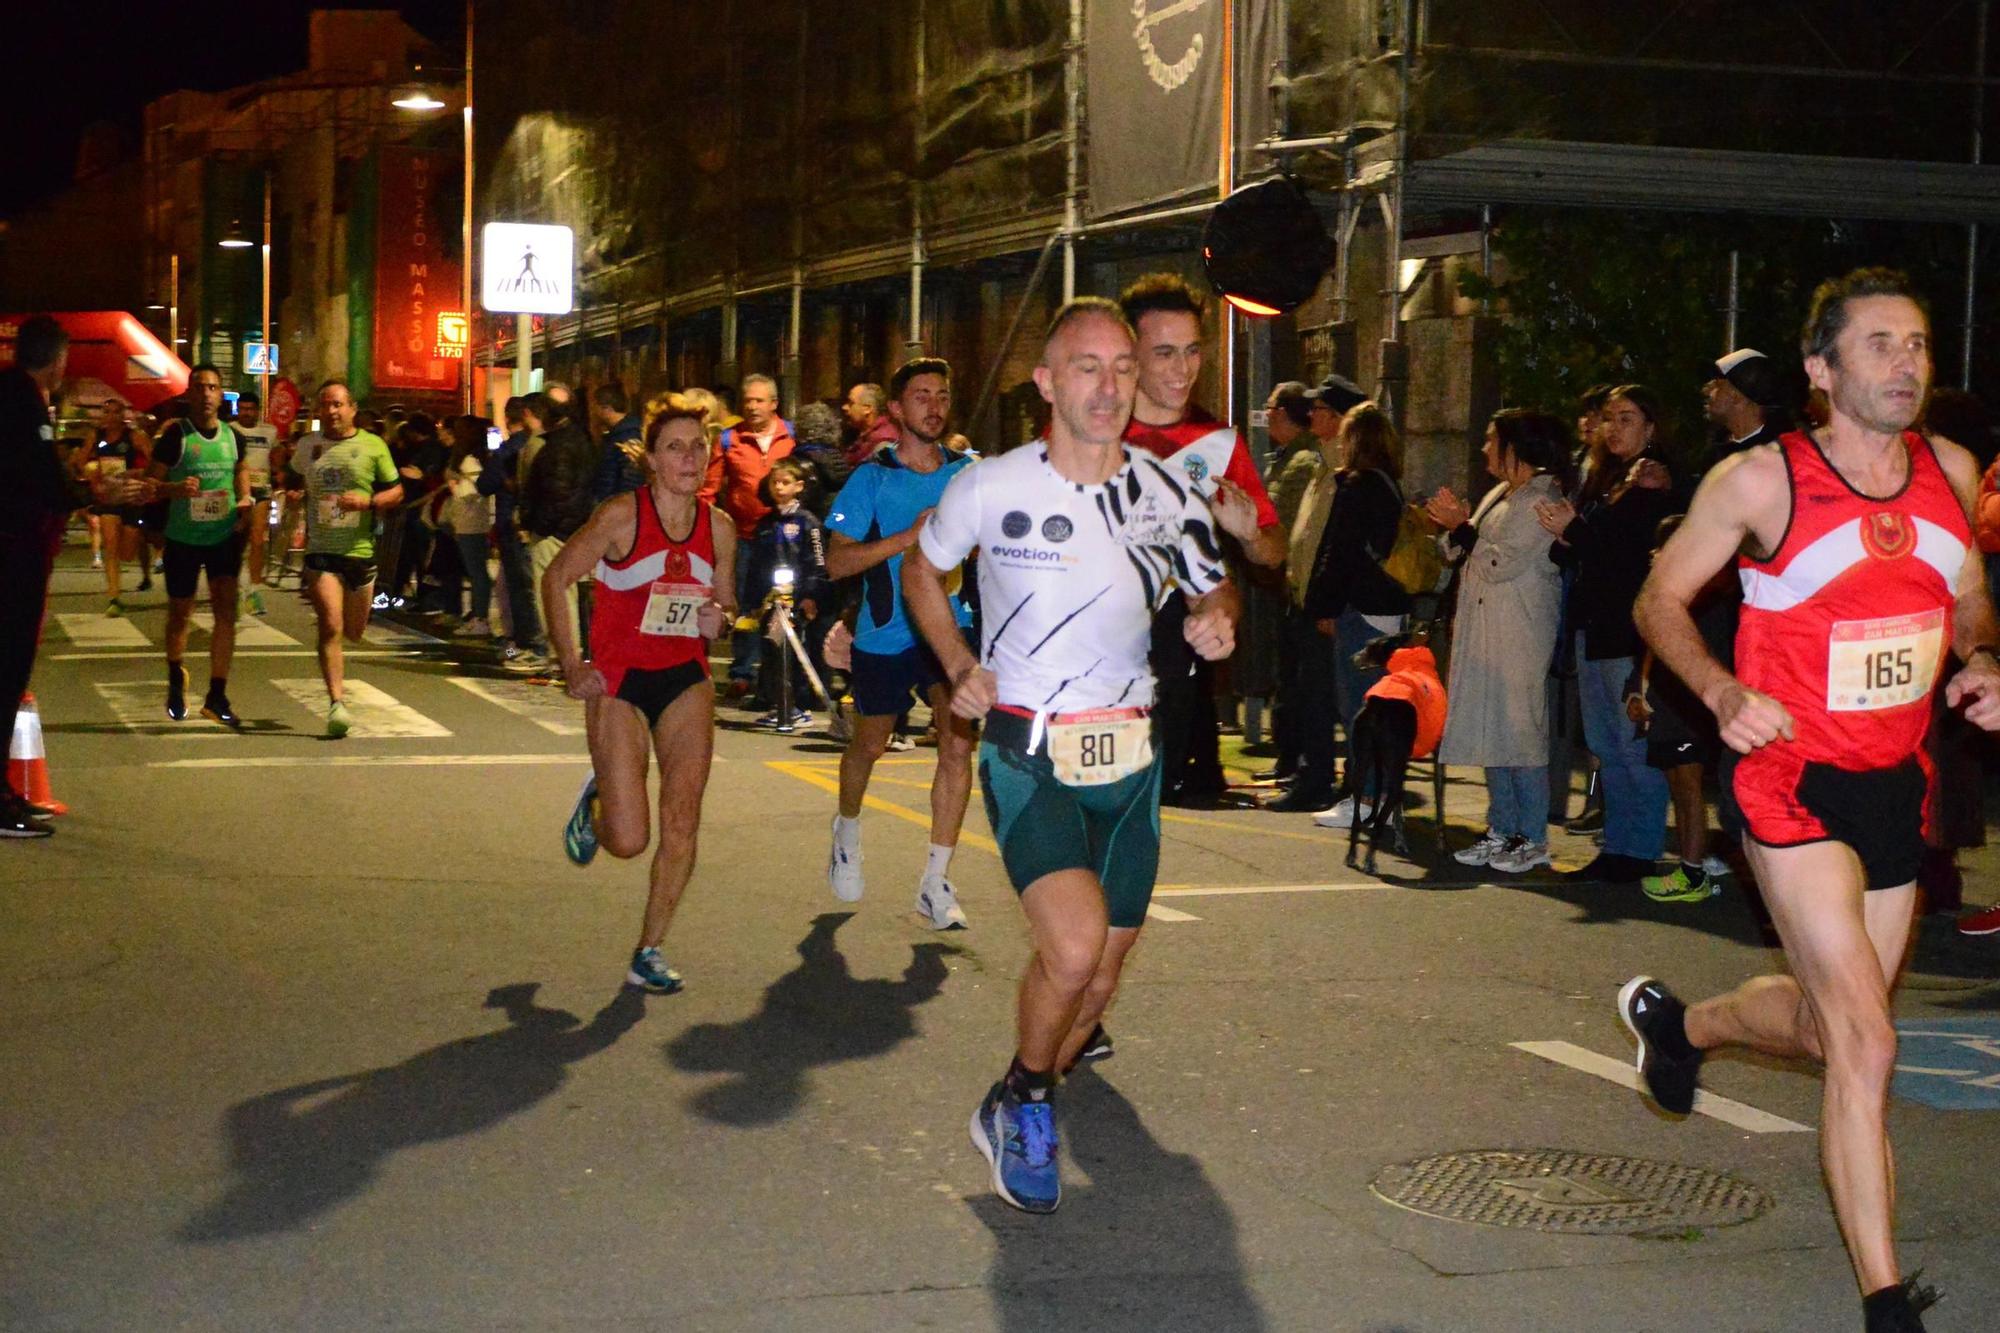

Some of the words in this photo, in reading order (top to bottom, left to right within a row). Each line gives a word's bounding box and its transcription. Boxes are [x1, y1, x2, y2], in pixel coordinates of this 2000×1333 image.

[412, 158, 430, 246] MUSEO
[991, 545, 1061, 562] evotion
[665, 602, 692, 625] 57
[1864, 647, 1913, 690] 165
[1081, 733, 1114, 767] 80
